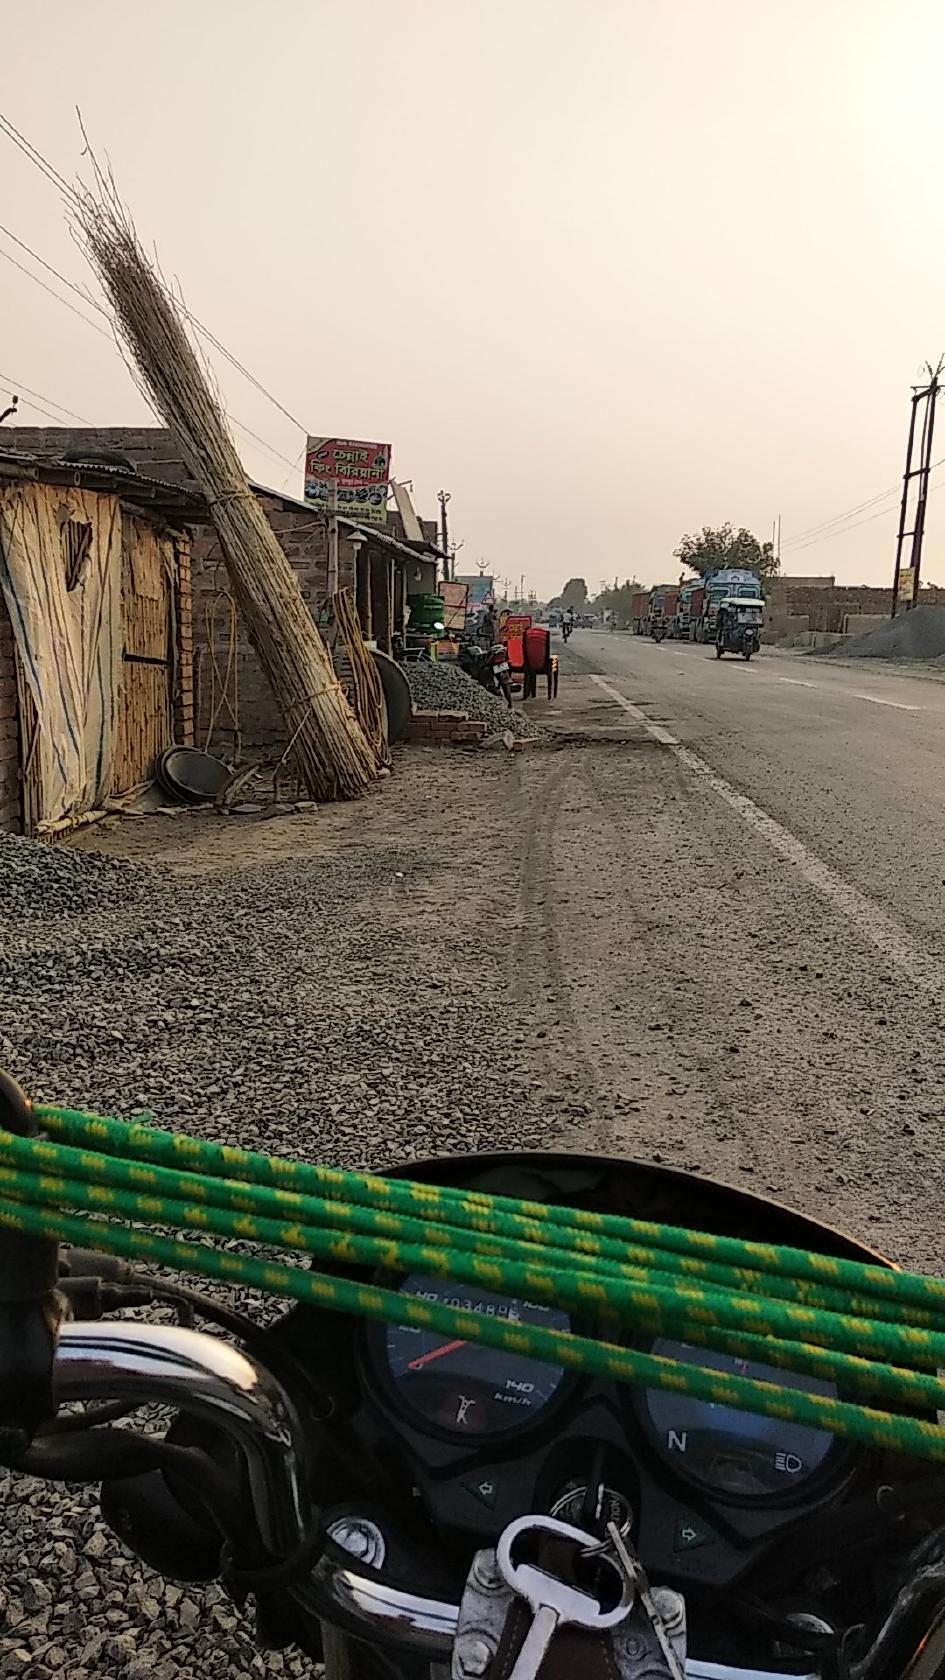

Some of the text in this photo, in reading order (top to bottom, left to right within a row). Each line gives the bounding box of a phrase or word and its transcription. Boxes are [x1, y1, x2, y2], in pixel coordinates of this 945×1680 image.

[505, 1379, 535, 1393] 140
[494, 1392, 532, 1405] km/h
[667, 1429, 687, 1452] N
